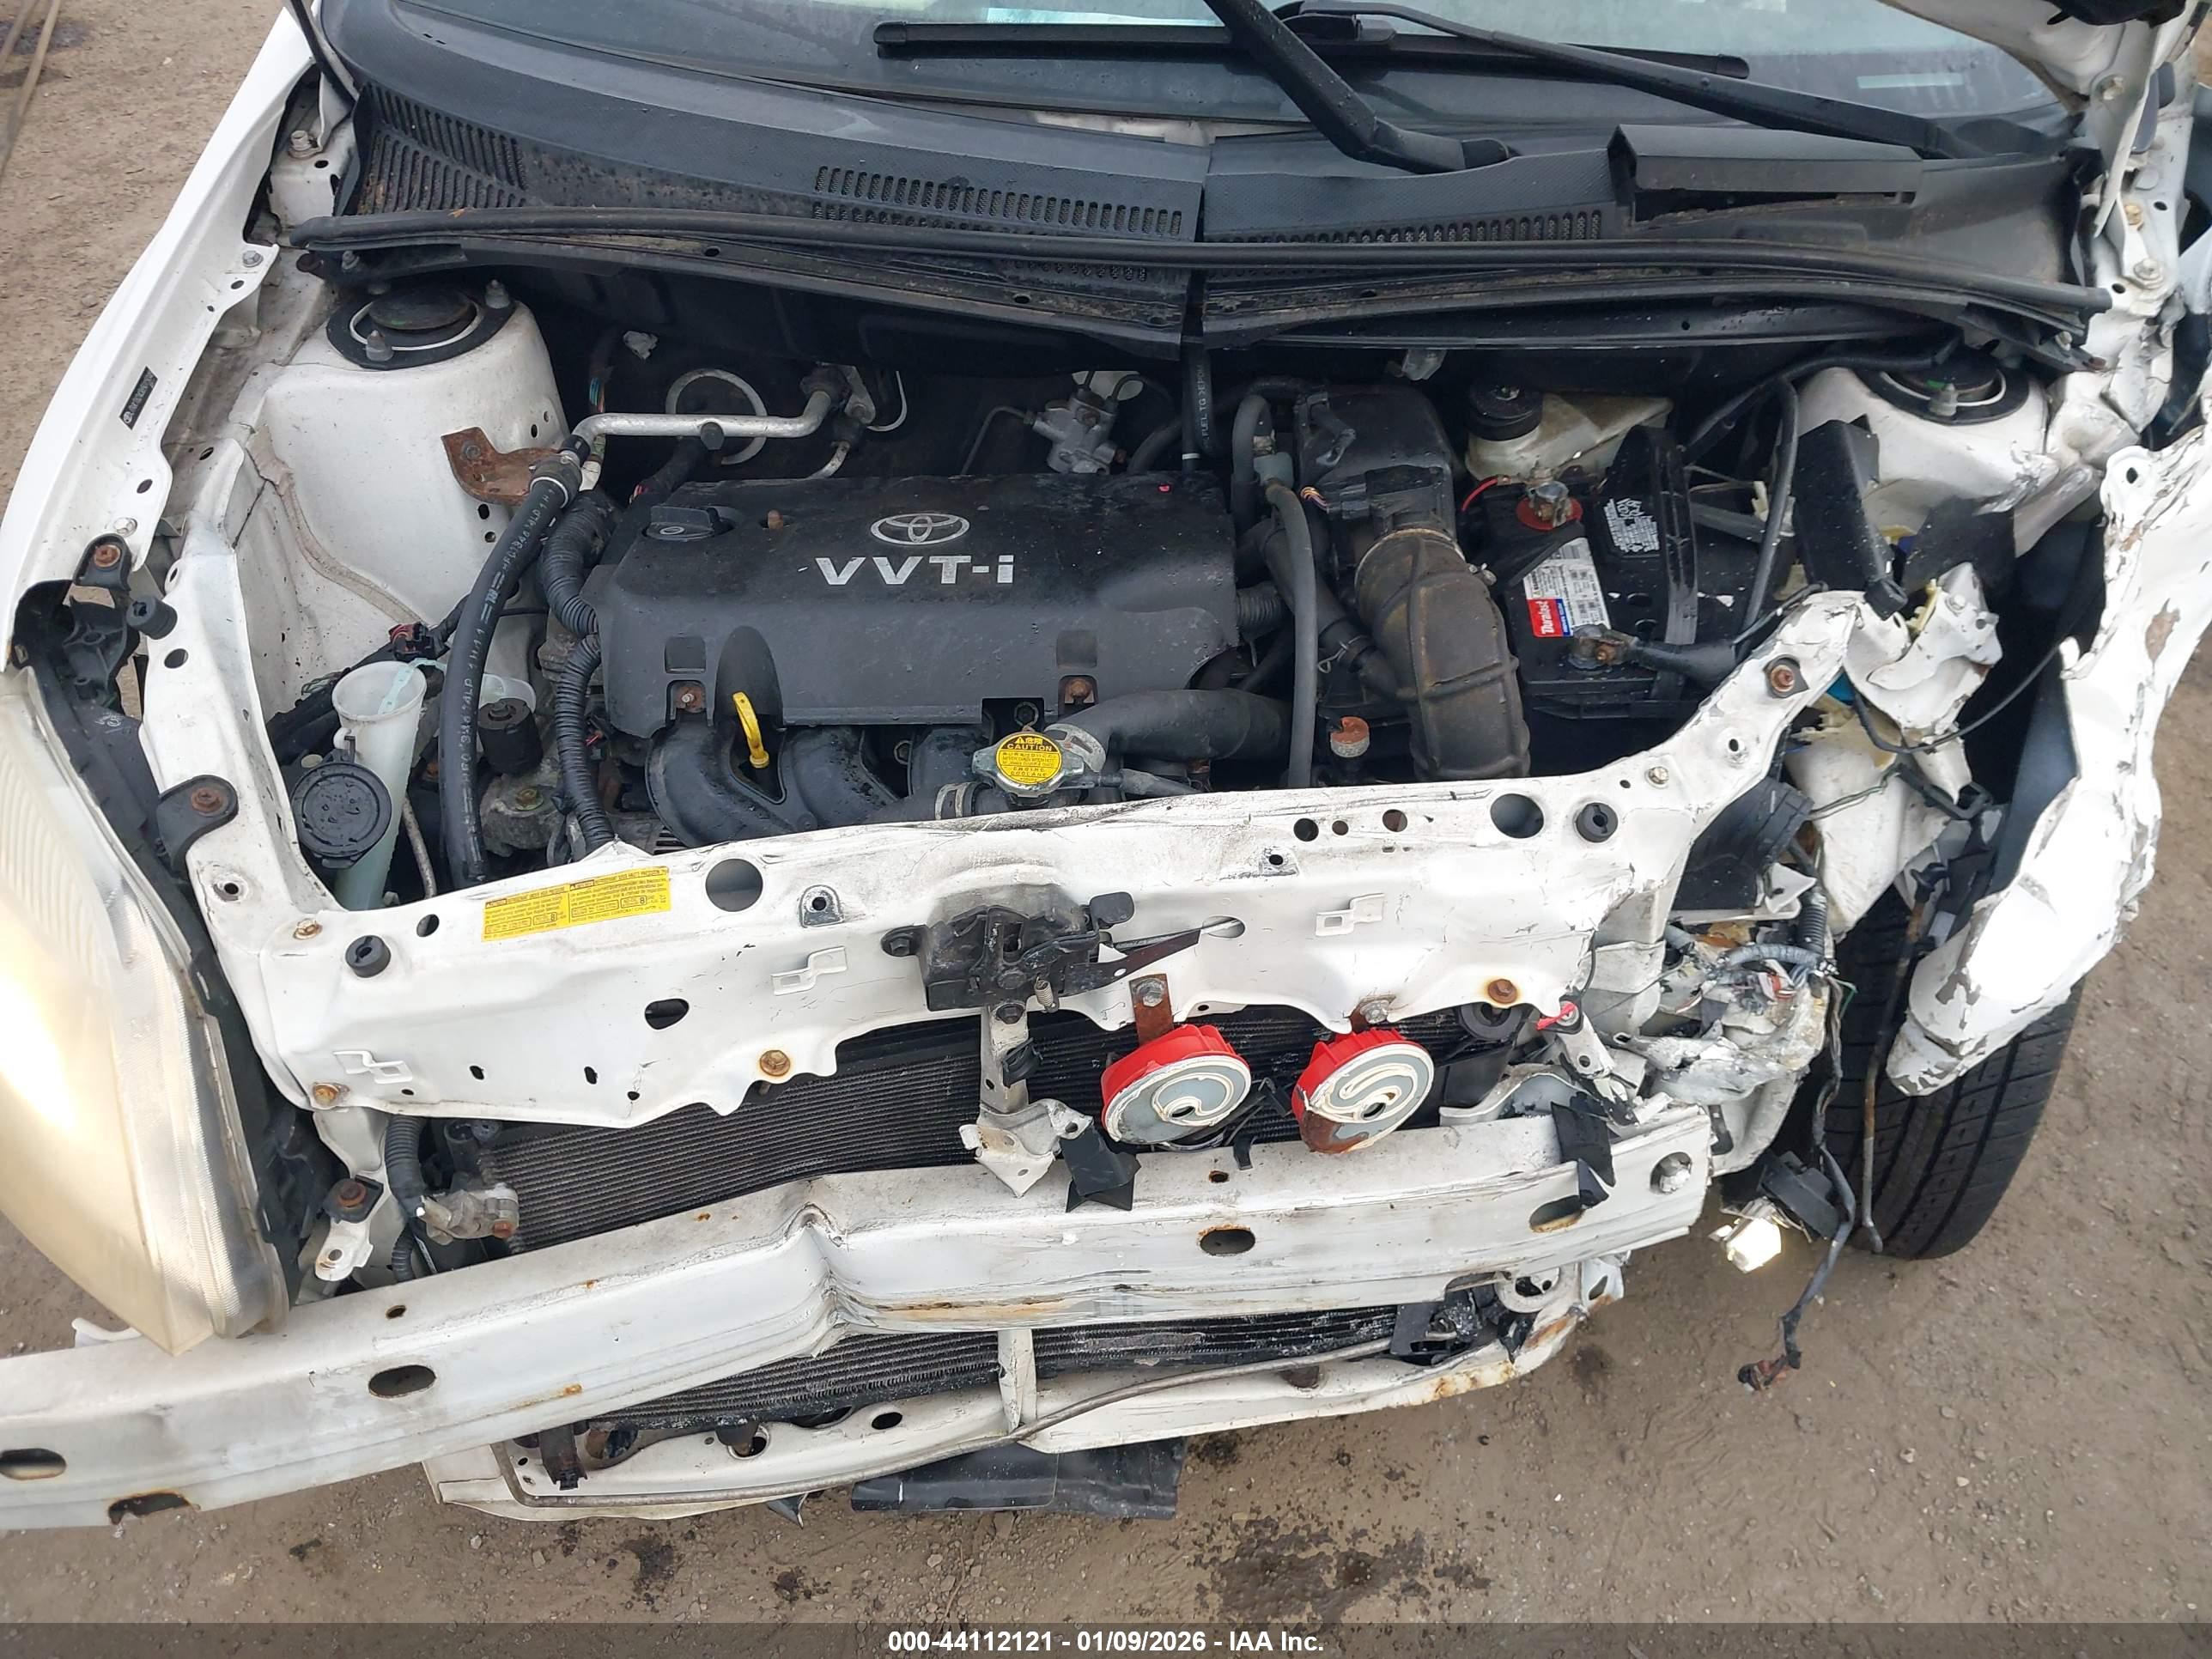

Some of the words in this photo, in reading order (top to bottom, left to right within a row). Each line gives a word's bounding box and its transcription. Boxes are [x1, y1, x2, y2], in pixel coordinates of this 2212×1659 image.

[816, 555, 1014, 585] VVT-i
[1535, 601, 1555, 635] Duralast
[1006, 743, 1052, 751] CAUTION
